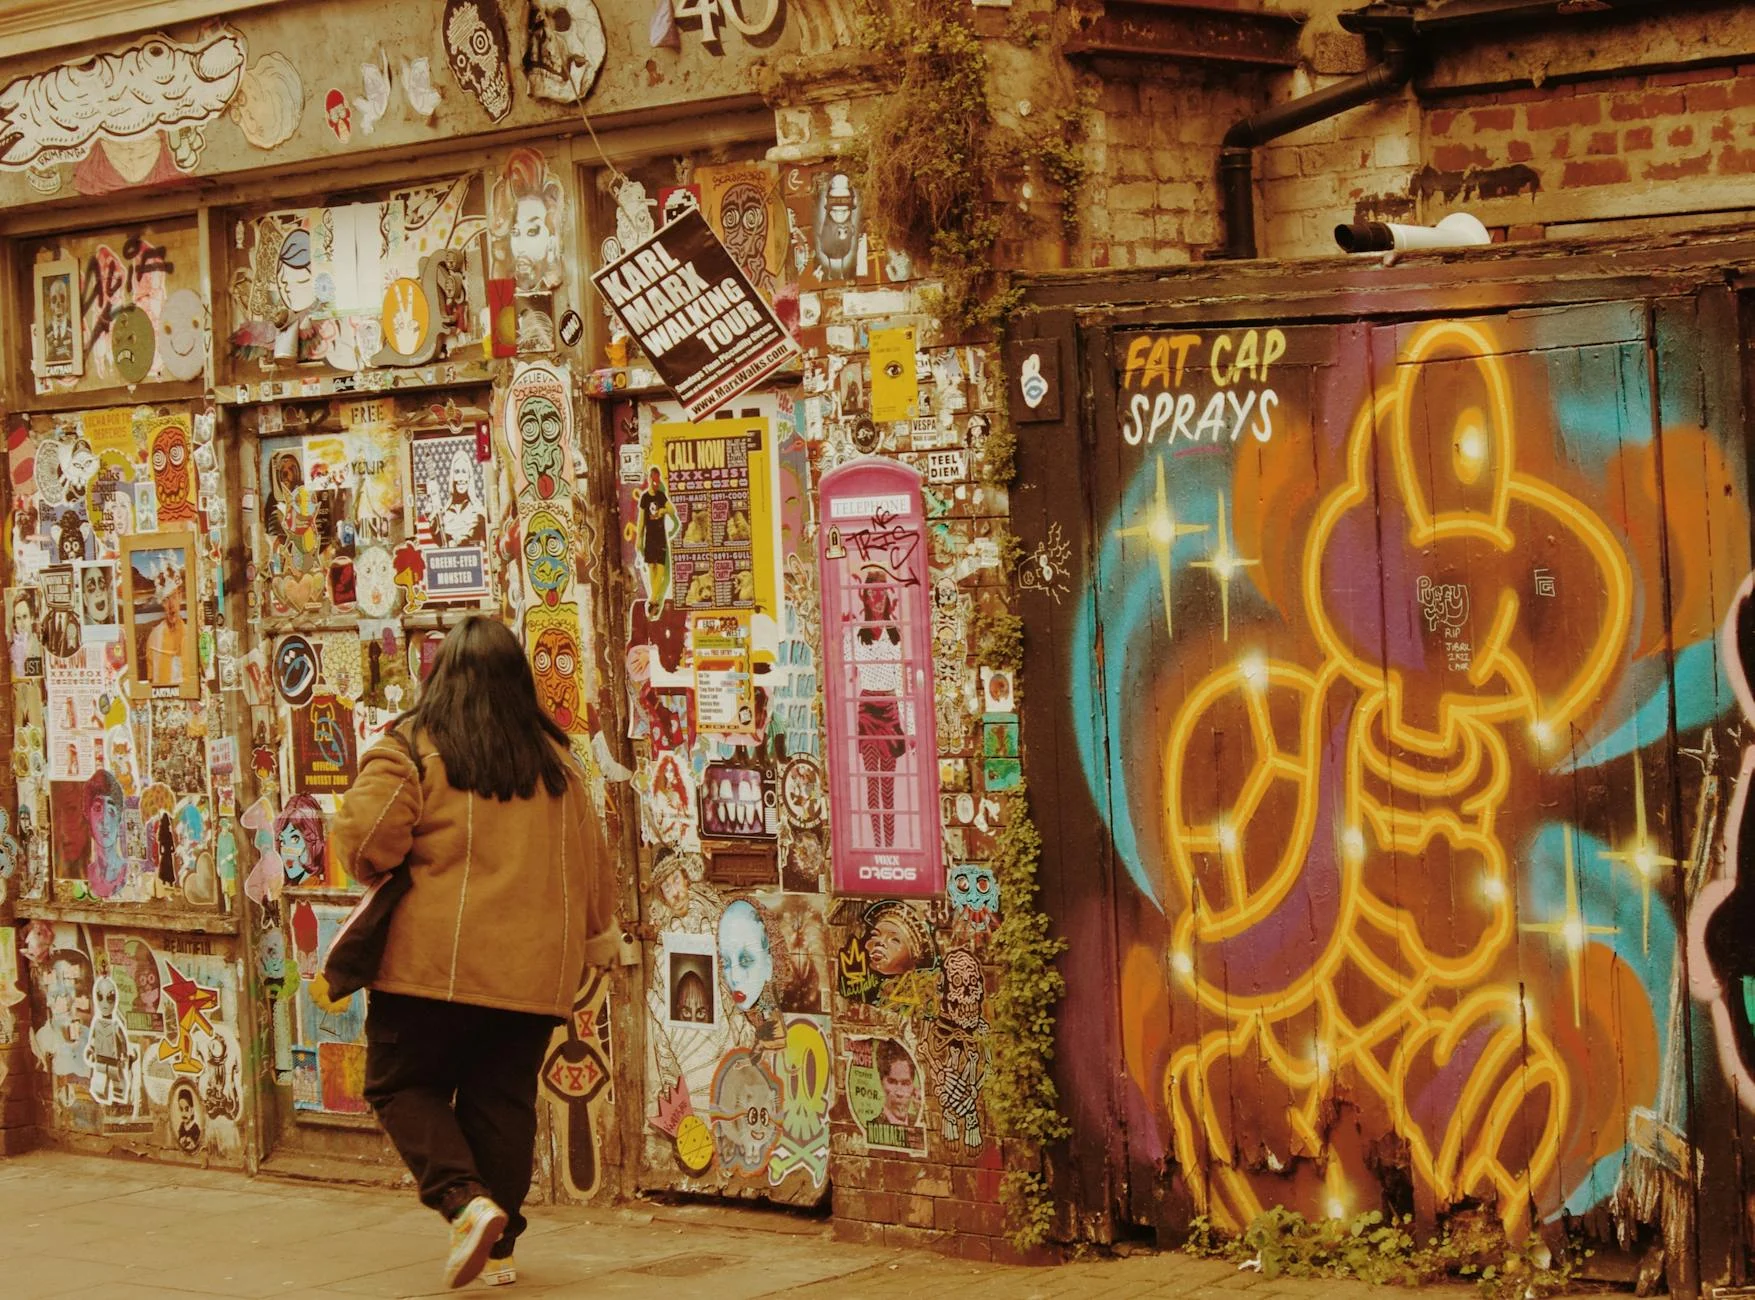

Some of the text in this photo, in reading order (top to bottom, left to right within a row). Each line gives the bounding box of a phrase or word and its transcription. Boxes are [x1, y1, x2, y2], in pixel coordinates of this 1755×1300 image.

[600, 241, 680, 307] KARL
[621, 261, 710, 336] MARX
[641, 278, 746, 358] WALKING
[696, 301, 763, 353] TOUR
[719, 337, 753, 363] Piccadilly
[750, 323, 773, 341] Circus
[1124, 329, 1286, 389] FAT CAP
[691, 343, 787, 414] www.MarxWalks.com
[351, 404, 384, 425] FREE
[913, 419, 936, 431] VESPA
[1123, 389, 1279, 445] SPRAYS
[351, 460, 385, 475] YOUR
[668, 442, 695, 471] CALL
[697, 440, 725, 469] NOW
[931, 452, 957, 465] TEEL
[931, 466, 959, 477] DIEM
[834, 497, 908, 516] TELEPHONE
[437, 570, 473, 584] MONSTER
